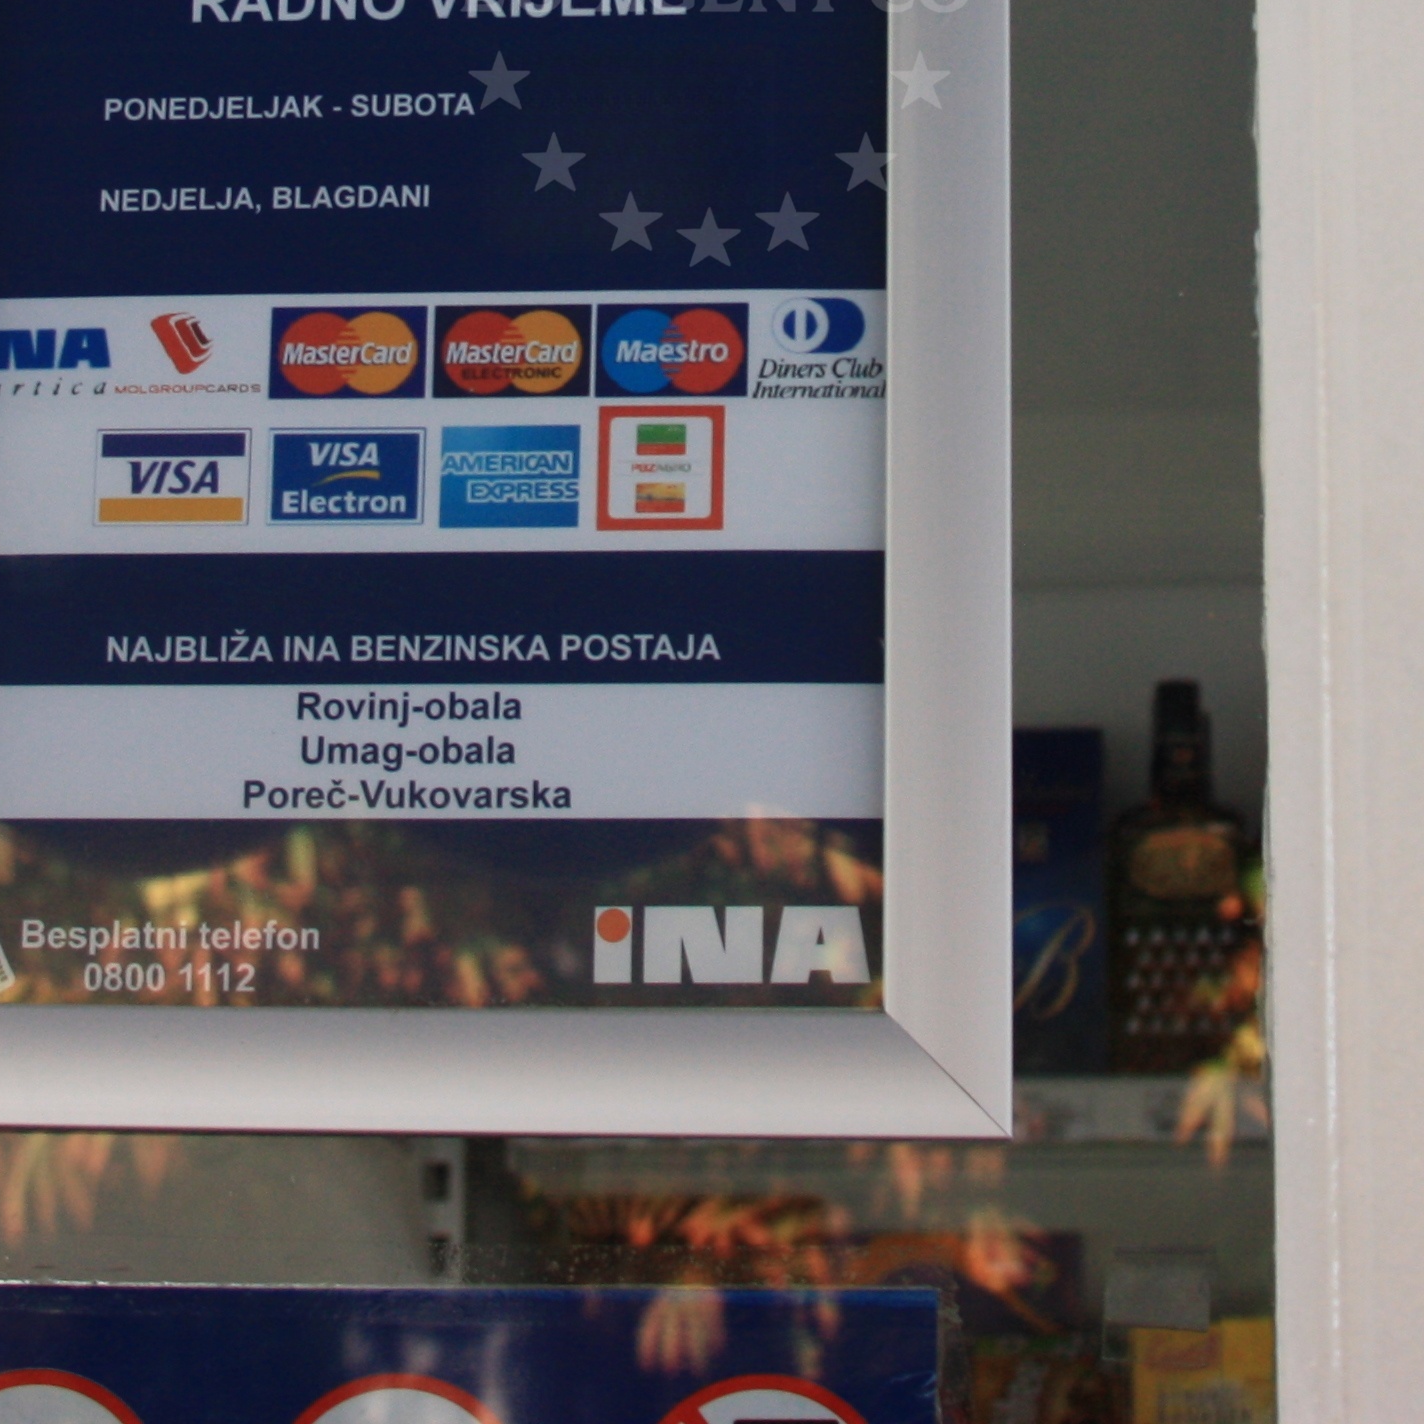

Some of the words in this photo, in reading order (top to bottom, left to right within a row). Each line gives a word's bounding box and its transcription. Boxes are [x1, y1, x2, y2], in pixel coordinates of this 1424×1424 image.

[105, 96, 322, 121] PONEDJELJAK
[351, 93, 475, 117] SUBOTA
[102, 188, 260, 212] NEDJELJA,
[274, 185, 428, 208] BLAGDANI
[282, 341, 413, 366] MasterCard
[445, 340, 578, 365] MasterCard
[615, 339, 729, 363] Maestro
[461, 366, 563, 380] ELECTRONIC
[758, 358, 828, 379] Diners
[831, 357, 884, 379] Club
[752, 380, 887, 399] International
[308, 442, 380, 466] VISA
[442, 452, 573, 475] AMERICAN
[127, 460, 220, 494] VISA
[282, 491, 407, 514] Electron
[467, 480, 580, 503] EXPRESS
[107, 630, 273, 662] NAJBLIŽA
[284, 636, 340, 661] INA
[351, 634, 550, 661] BENZINSKA
[561, 634, 720, 660] POSTAJA
[296, 691, 523, 727] Rovinj-obala
[300, 736, 517, 769] Umag-obala
[242, 780, 573, 810] Poreč-Vukovarska
[23, 920, 188, 956] Besplatni
[200, 920, 318, 950] telefon
[593, 905, 871, 984] INA
[84, 963, 164, 991] 0800
[179, 962, 255, 993] 1112
